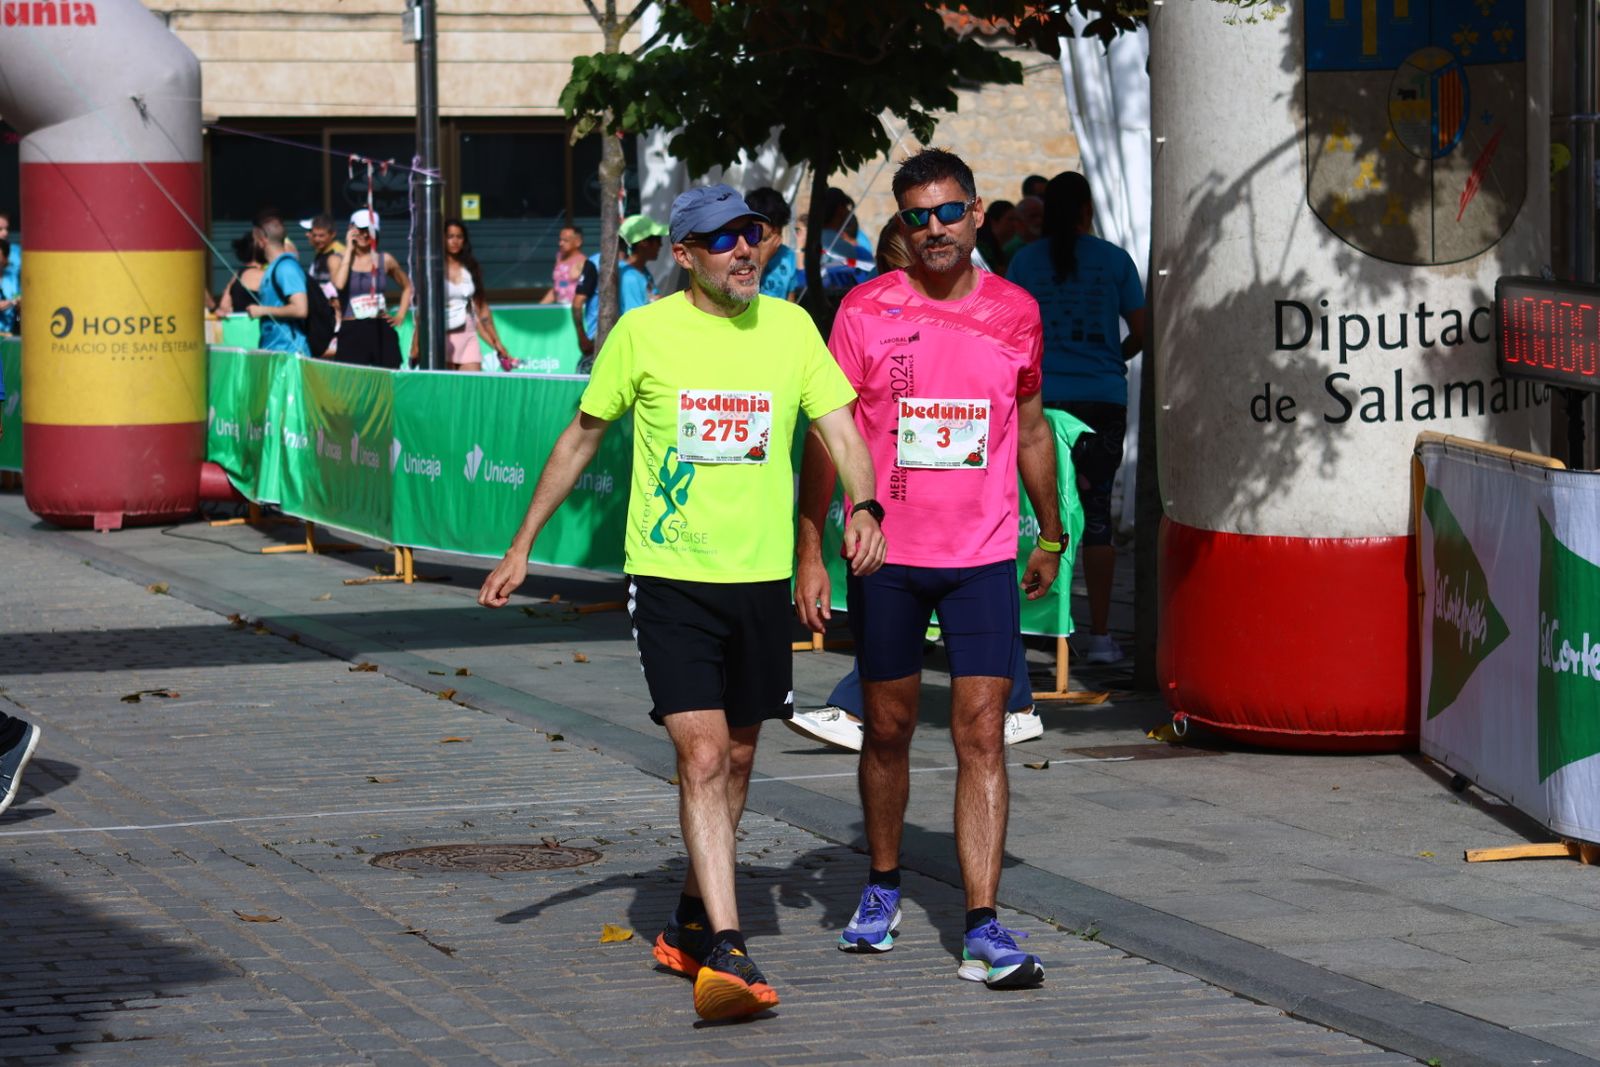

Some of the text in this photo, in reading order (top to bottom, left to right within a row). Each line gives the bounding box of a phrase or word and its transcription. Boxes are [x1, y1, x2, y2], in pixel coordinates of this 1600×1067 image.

[83, 316, 177, 335] HOSPES
[51, 343, 107, 354] PALACIO
[111, 342, 128, 354] DE
[133, 342, 158, 353] SAN
[681, 393, 770, 413] bedunia
[901, 401, 987, 420] bedunia
[1250, 382, 1298, 424] de
[701, 419, 749, 442] 275
[936, 427, 951, 448] 3
[403, 453, 441, 482] Unicaja
[484, 460, 525, 491] Unicaja
